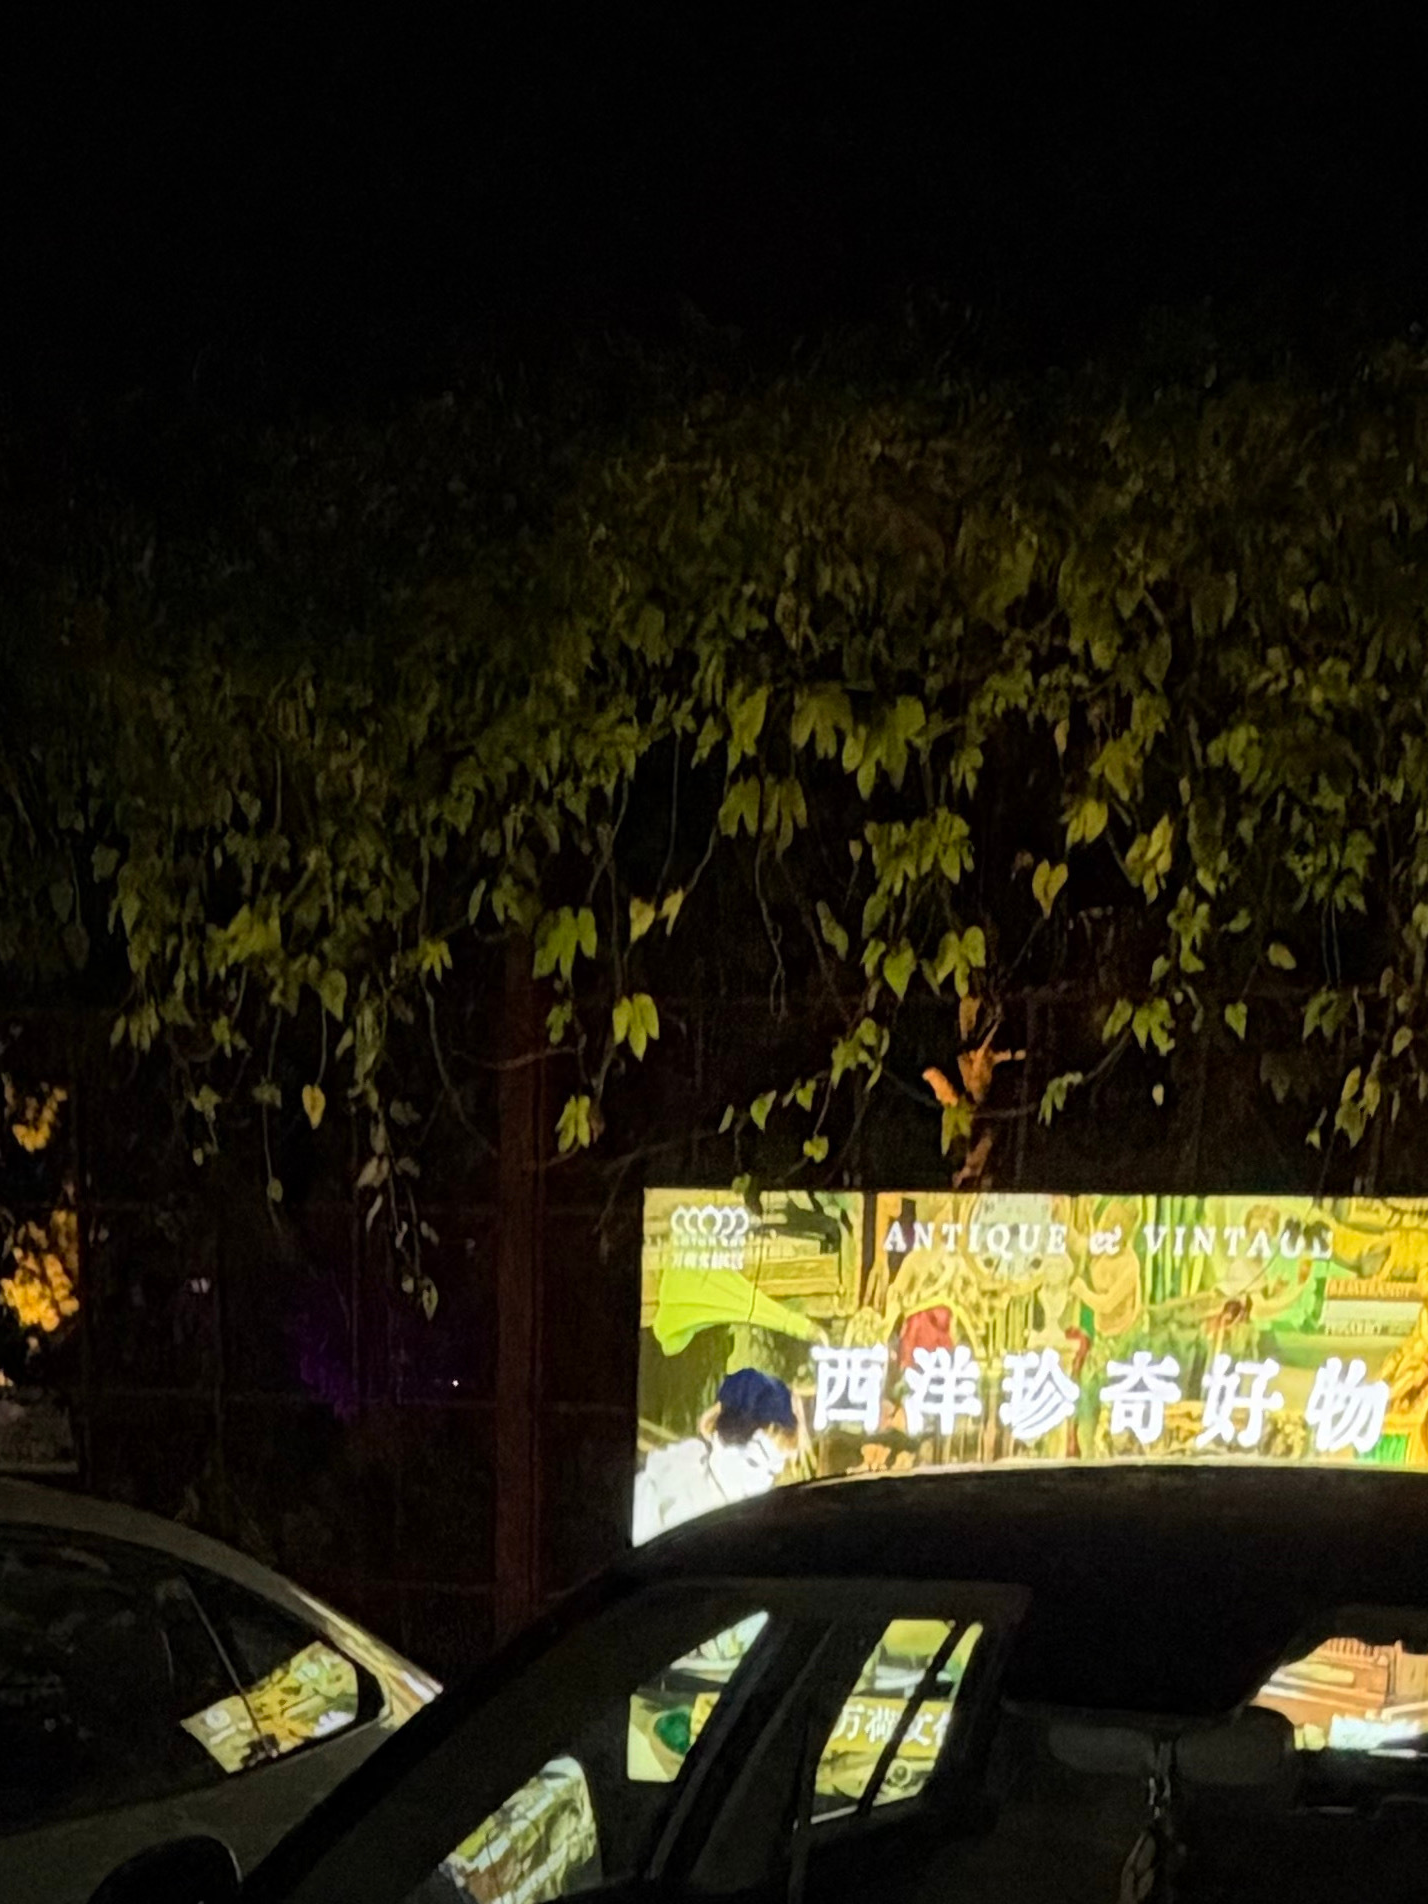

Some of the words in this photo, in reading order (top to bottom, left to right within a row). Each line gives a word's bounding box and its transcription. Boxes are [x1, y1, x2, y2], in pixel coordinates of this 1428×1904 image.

[882, 1220, 1068, 1260] ANTIQUE
[809, 1344, 1391, 1454] 西洋珍奇好物
